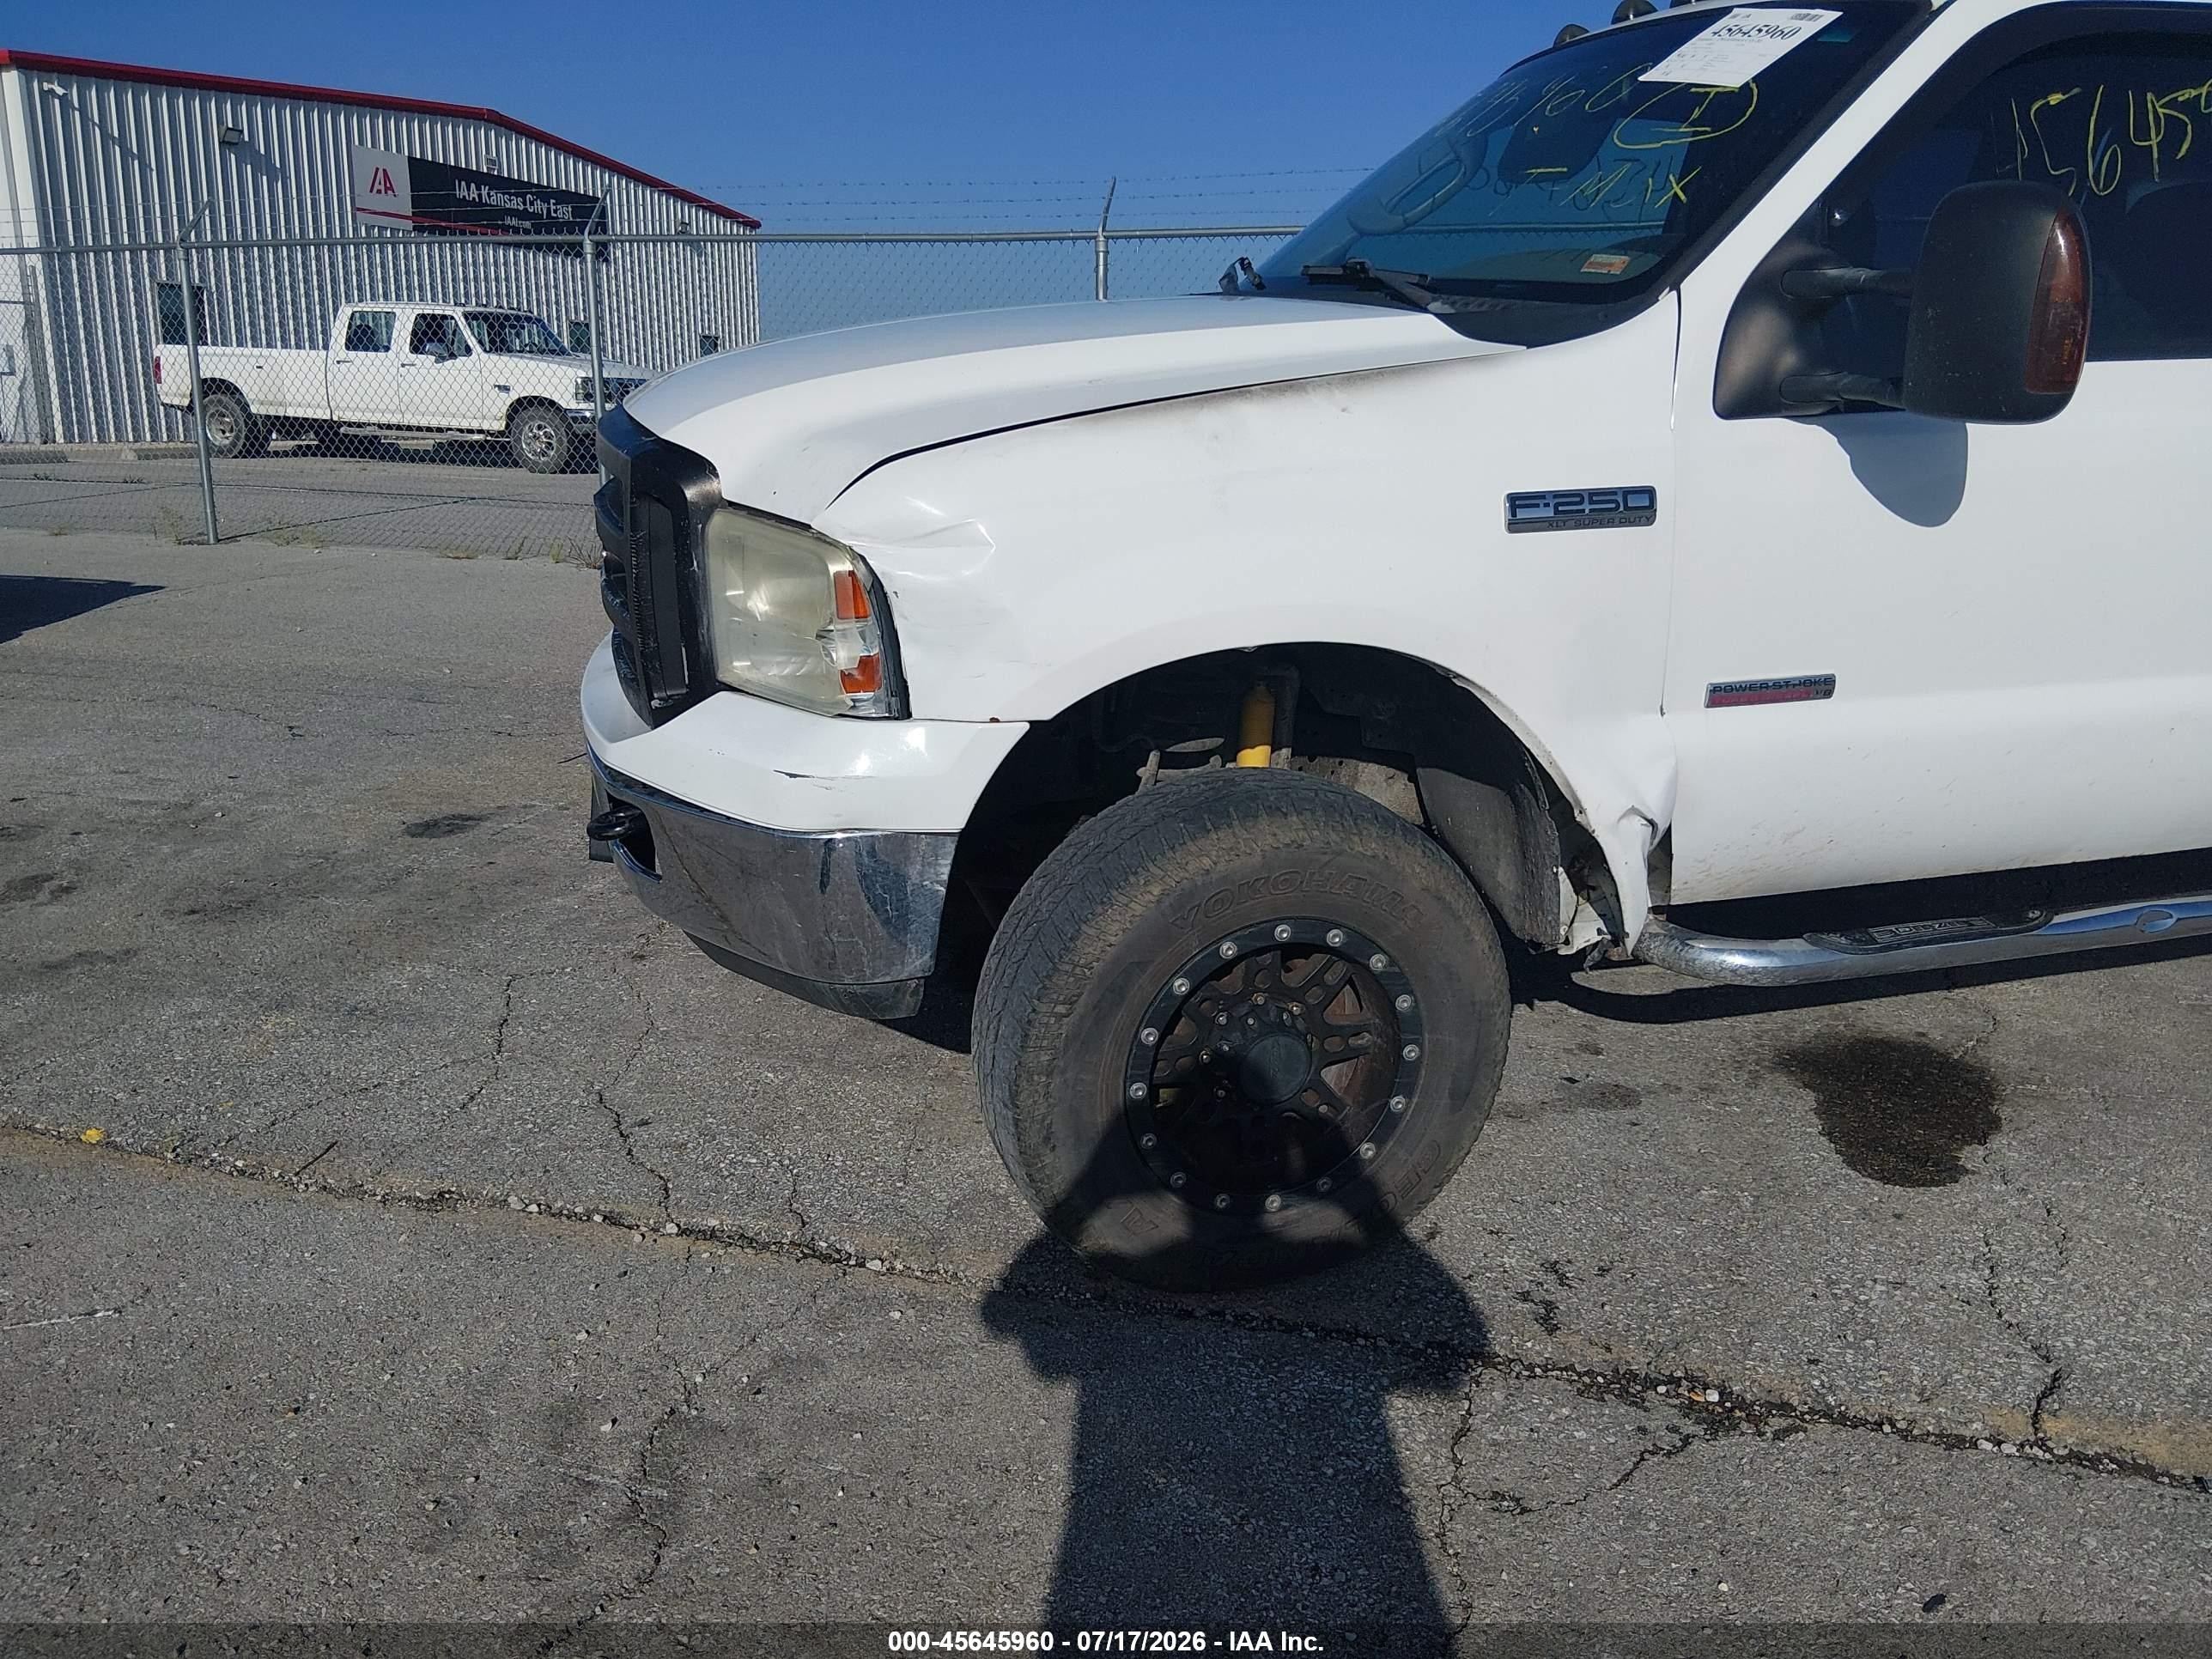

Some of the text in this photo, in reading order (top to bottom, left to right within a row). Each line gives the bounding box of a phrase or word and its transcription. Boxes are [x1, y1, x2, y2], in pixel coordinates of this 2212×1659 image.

[1711, 24, 1802, 40] 45645960
[455, 179, 574, 221] IAA Kansas City East
[1510, 489, 1655, 518] F-250
[1547, 515, 1654, 529] XLT SUPER DUTY
